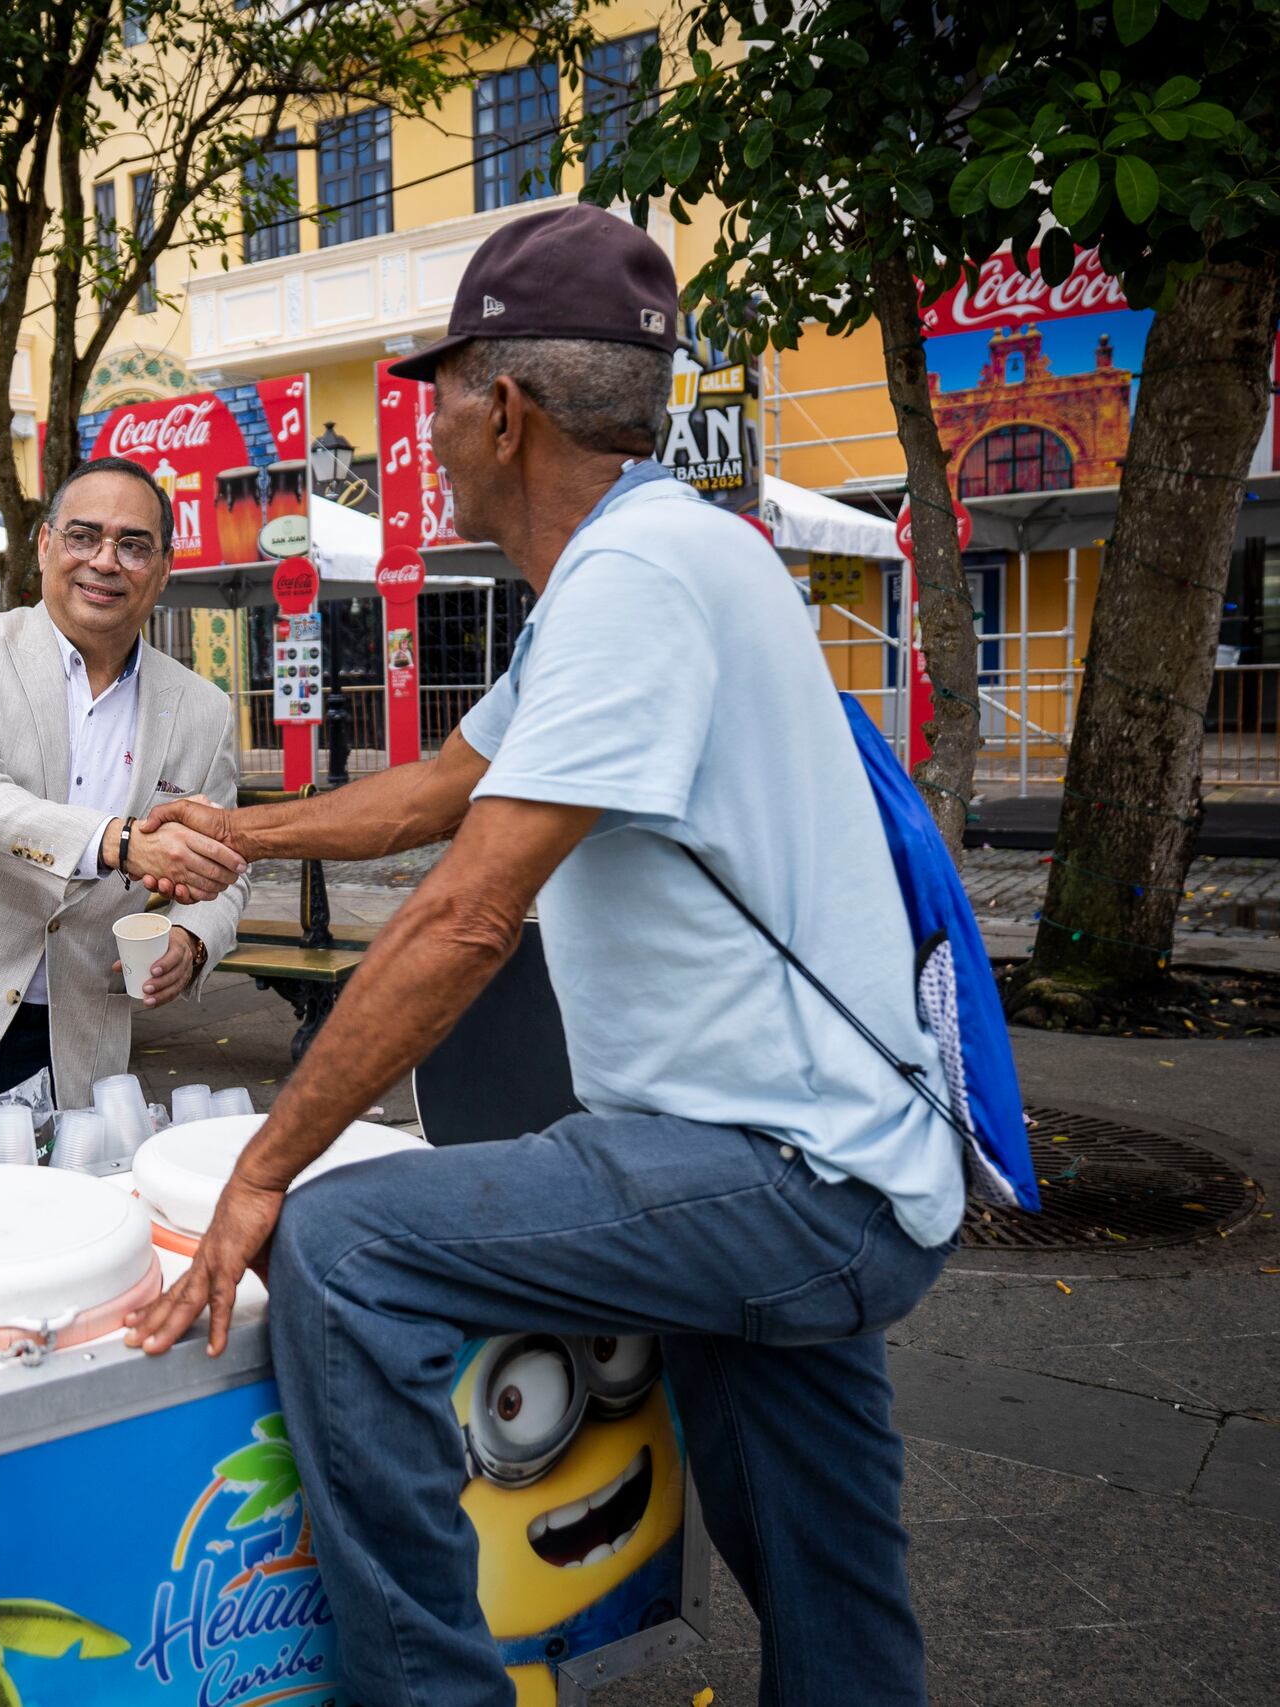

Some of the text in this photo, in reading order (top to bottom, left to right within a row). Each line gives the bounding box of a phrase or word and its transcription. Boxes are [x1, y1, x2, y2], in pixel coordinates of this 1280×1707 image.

[702, 367, 739, 390] CALLE
[109, 399, 215, 457] Coca-Cola
[711, 475, 743, 489] 2024
[378, 564, 421, 585] Coca-Cola
[198, 1626, 325, 1707] Caribe
